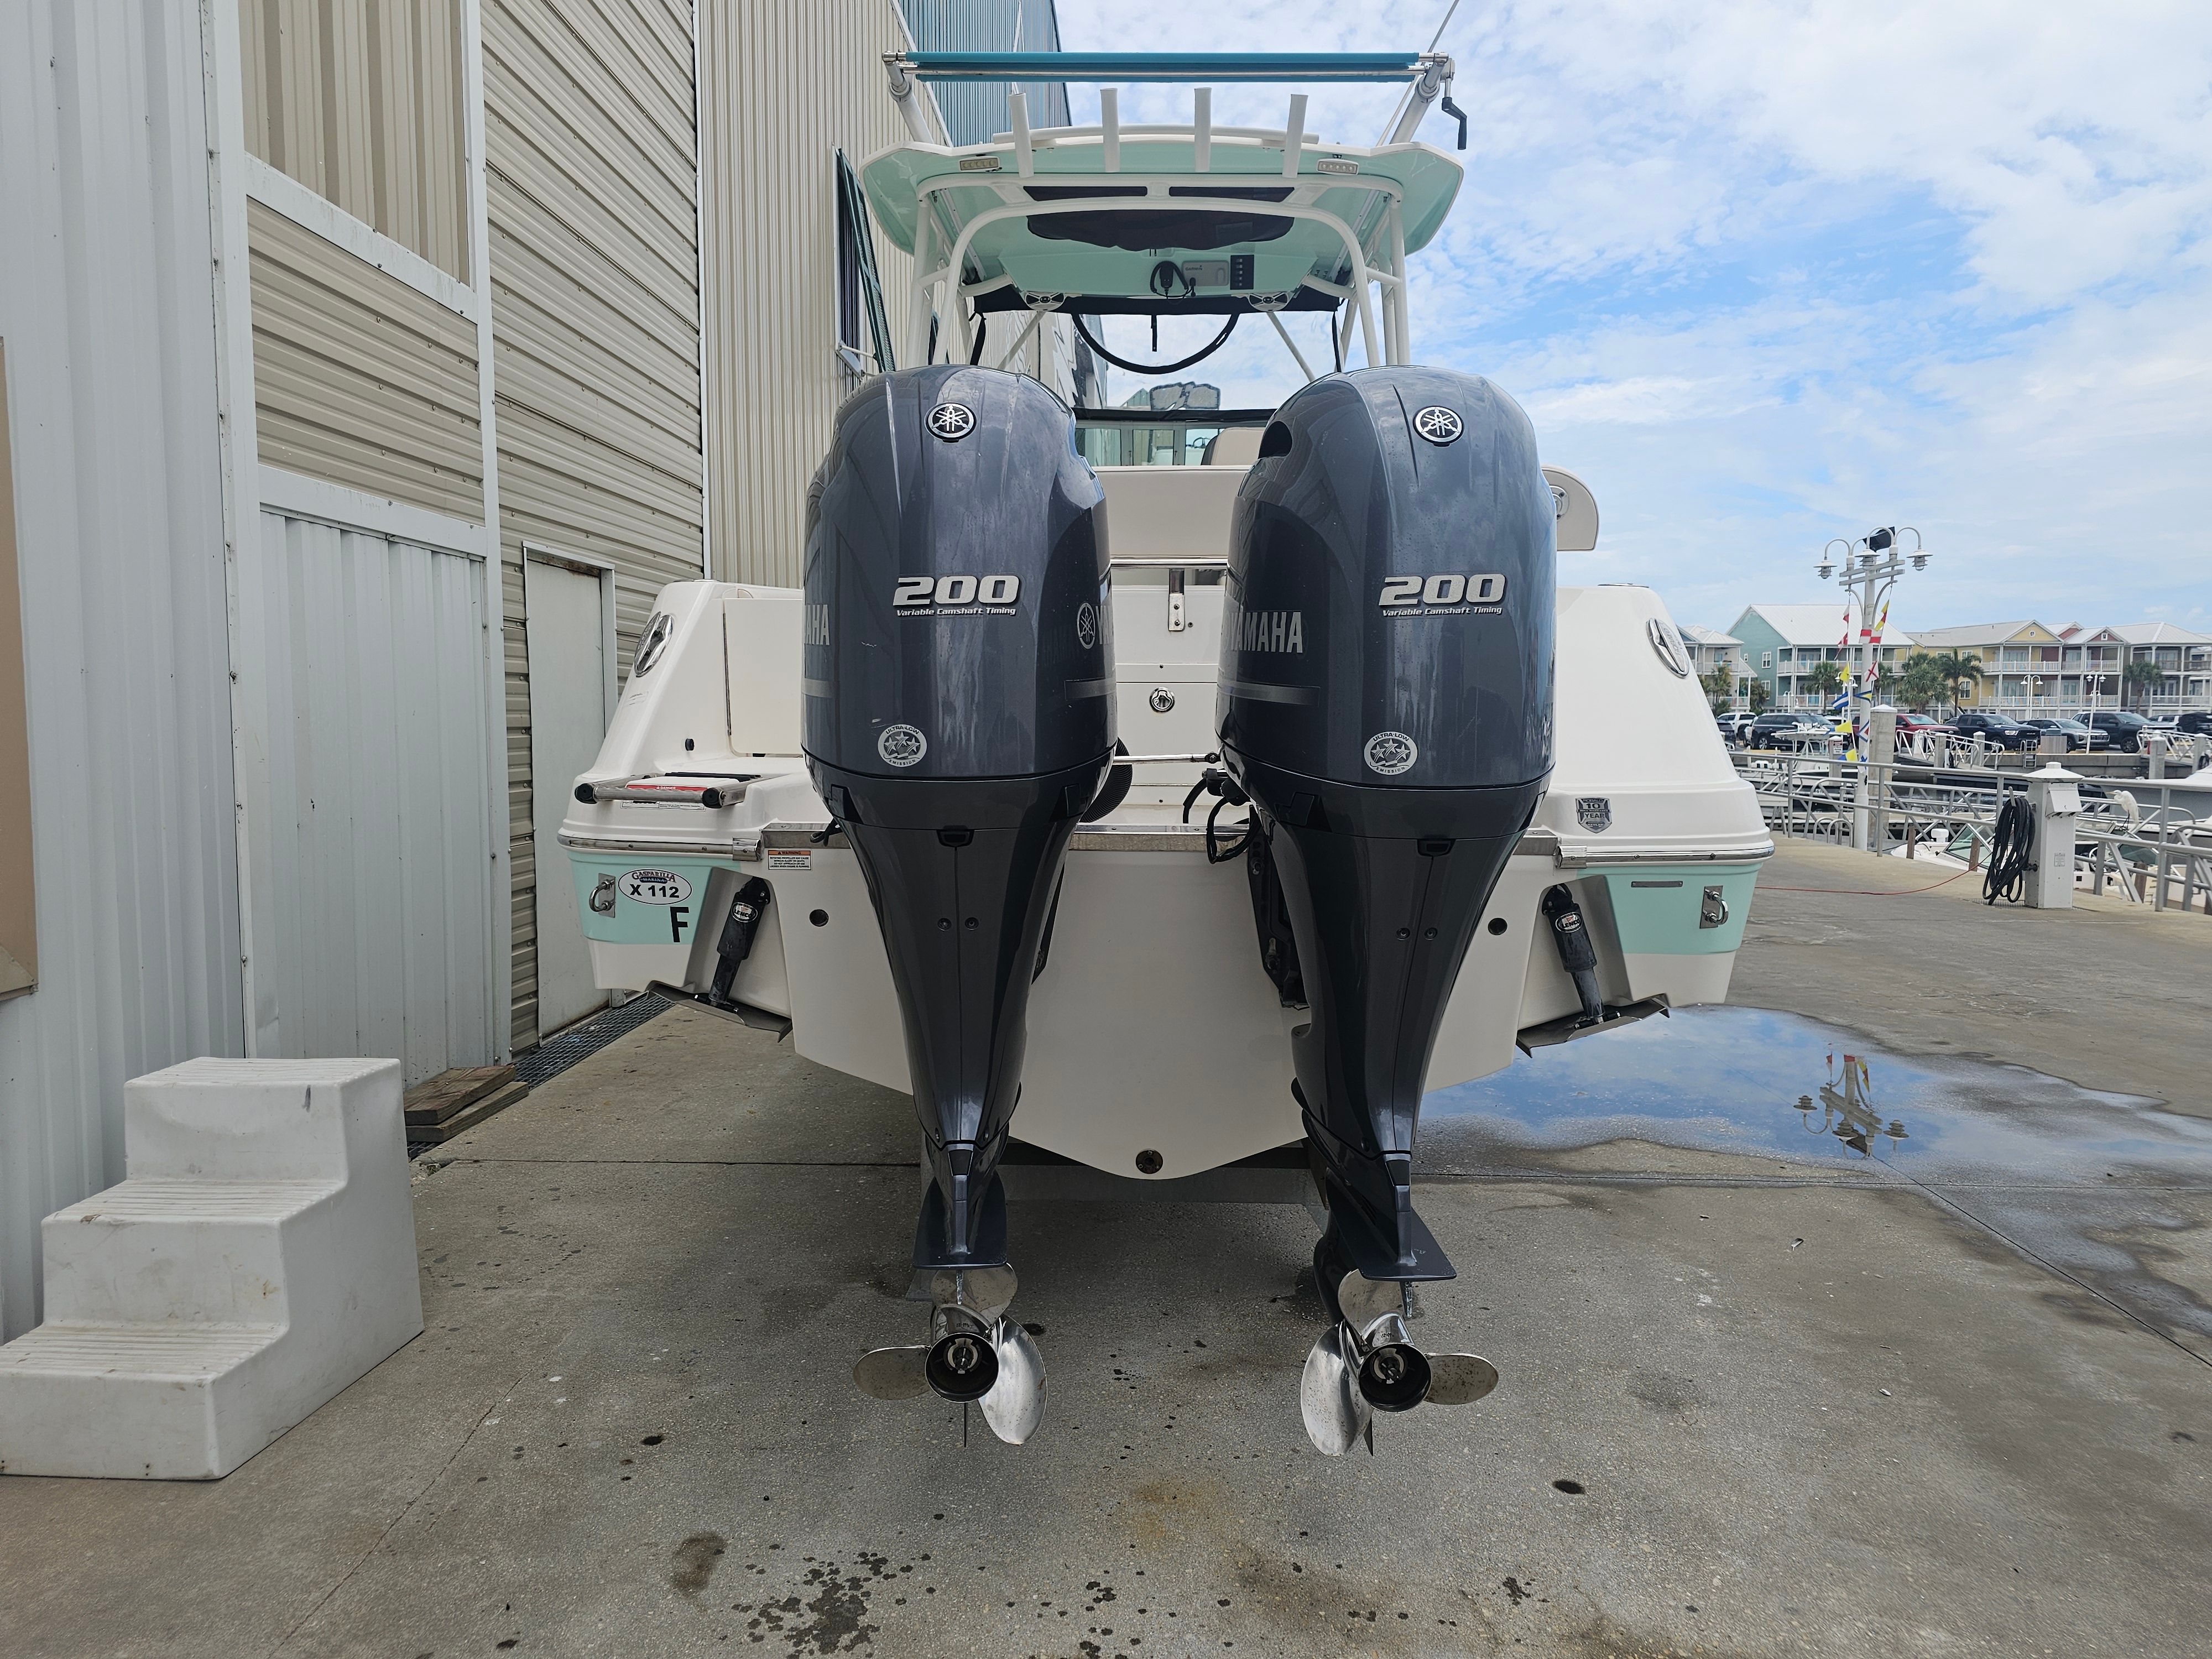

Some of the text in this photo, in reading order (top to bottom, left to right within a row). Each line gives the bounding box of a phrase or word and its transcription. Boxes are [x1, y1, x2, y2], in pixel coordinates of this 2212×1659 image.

[893, 575, 1020, 606] 200
[1379, 573, 1506, 606] 200
[986, 607, 1016, 615] Timing
[1473, 606, 1503, 614] Timing
[1230, 612, 1303, 653] YAMAHA
[632, 871, 677, 884] GASPARILLA
[629, 884, 680, 899] X 112
[734, 908, 753, 918] LENCO
[670, 906, 690, 943] F
[1562, 919, 1580, 928] LENCO
